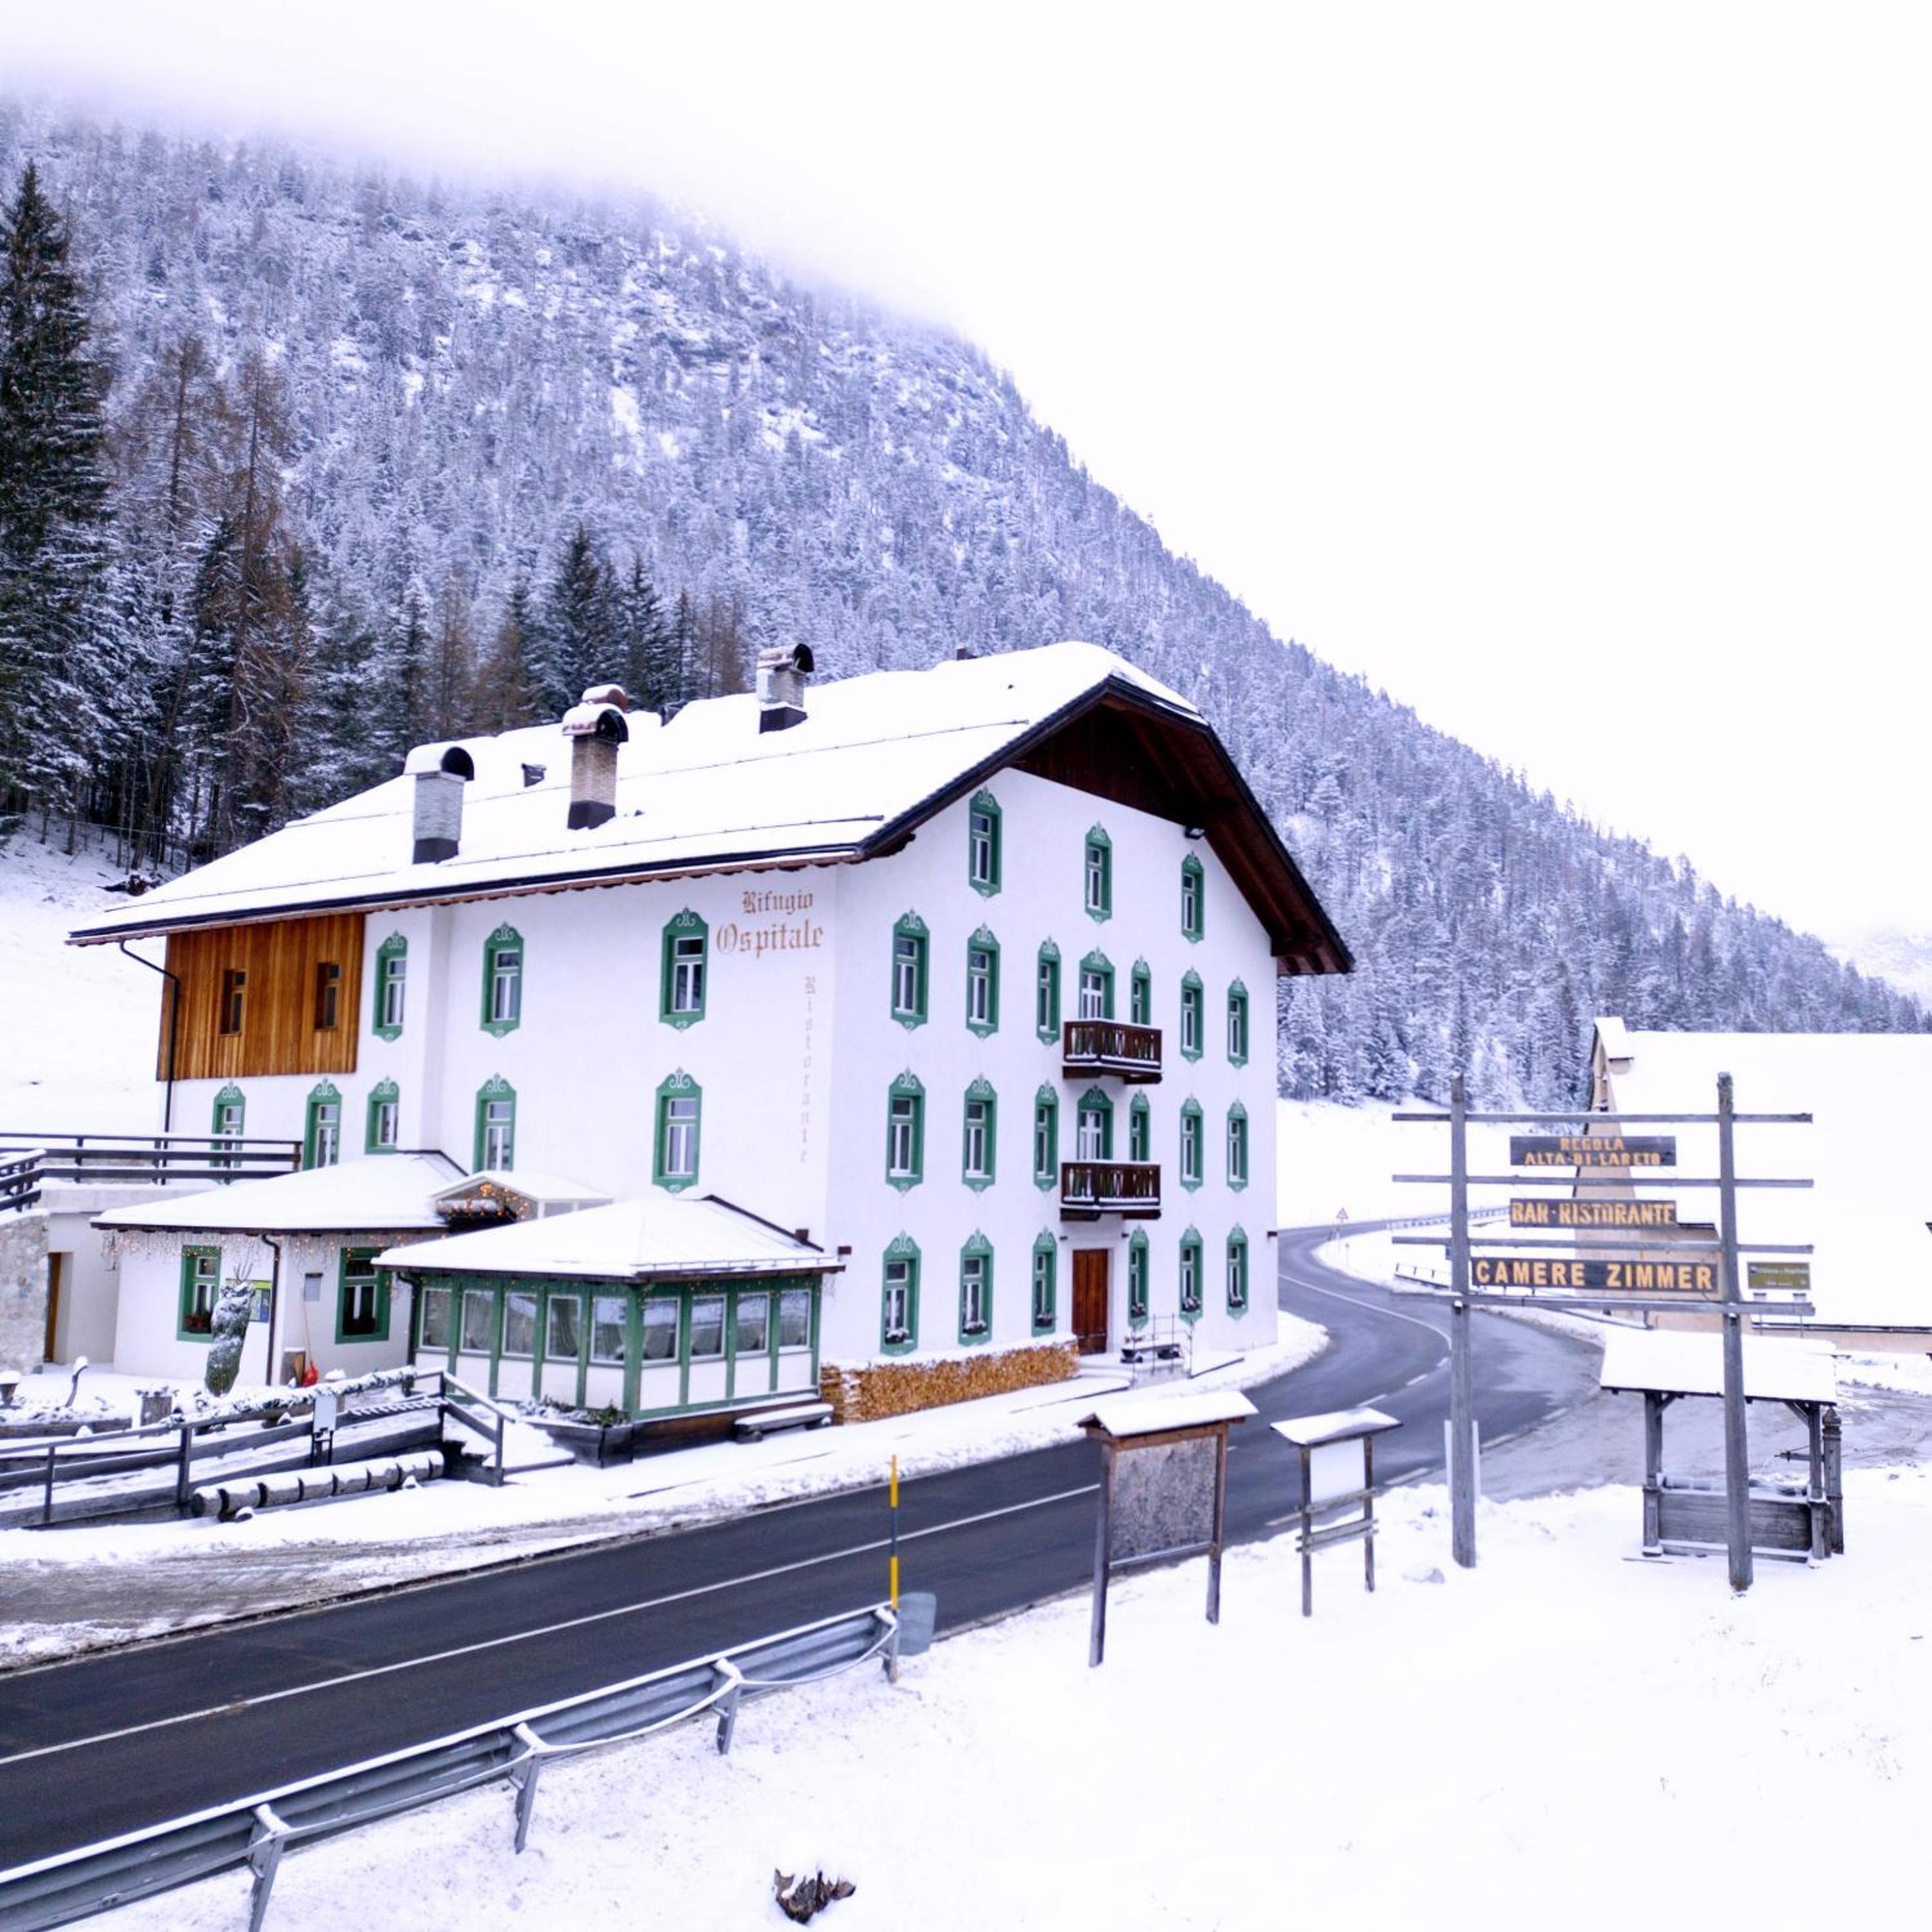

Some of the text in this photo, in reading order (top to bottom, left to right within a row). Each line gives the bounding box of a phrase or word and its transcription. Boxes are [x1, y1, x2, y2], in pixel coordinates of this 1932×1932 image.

[742, 890, 813, 915] Rifugio
[717, 920, 823, 958] Ospitale
[1559, 1138, 1625, 1151] REGOLA
[1525, 1152, 1566, 1165] ALTA
[1512, 1202, 1674, 1225] BAR RISTORANTE
[1476, 1261, 1713, 1290] CAMERE ZIMMER
